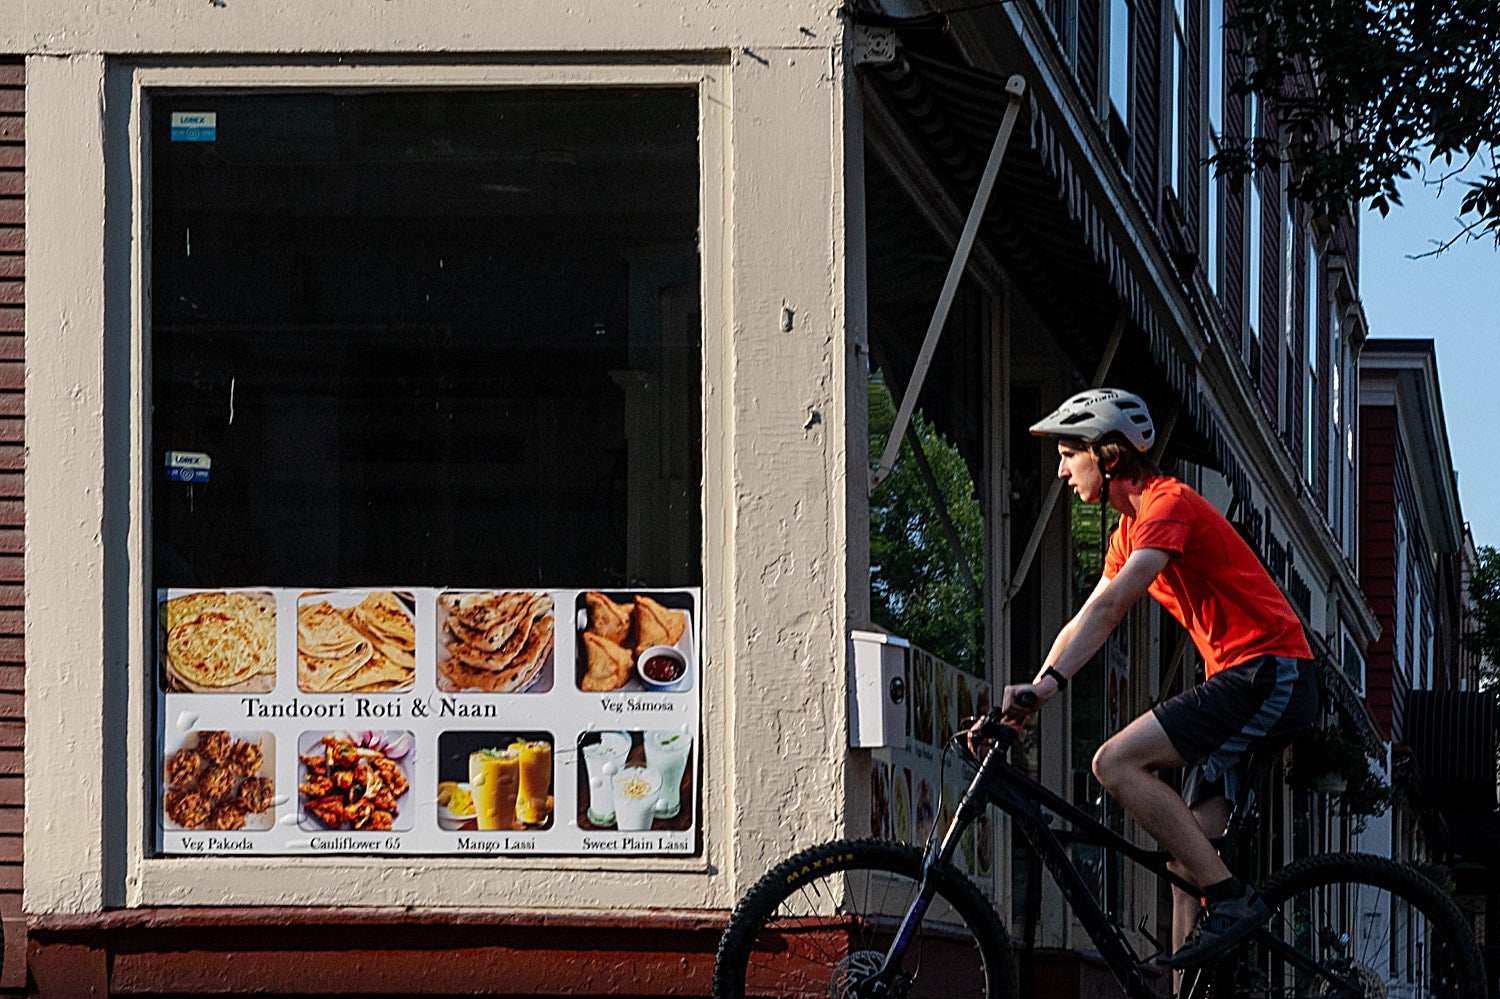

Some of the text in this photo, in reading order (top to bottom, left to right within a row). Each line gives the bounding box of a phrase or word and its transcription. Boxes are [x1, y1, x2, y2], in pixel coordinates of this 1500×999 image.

[242, 698, 497, 718] Tandoori Roti & Naan
[601, 699, 674, 713] Veg Samosa
[182, 837, 253, 852] Veg Pakoda
[310, 837, 401, 850] Cauliflower 65
[457, 837, 535, 852] Mango Lassi
[582, 837, 688, 851] Sweet Plain Lassi
